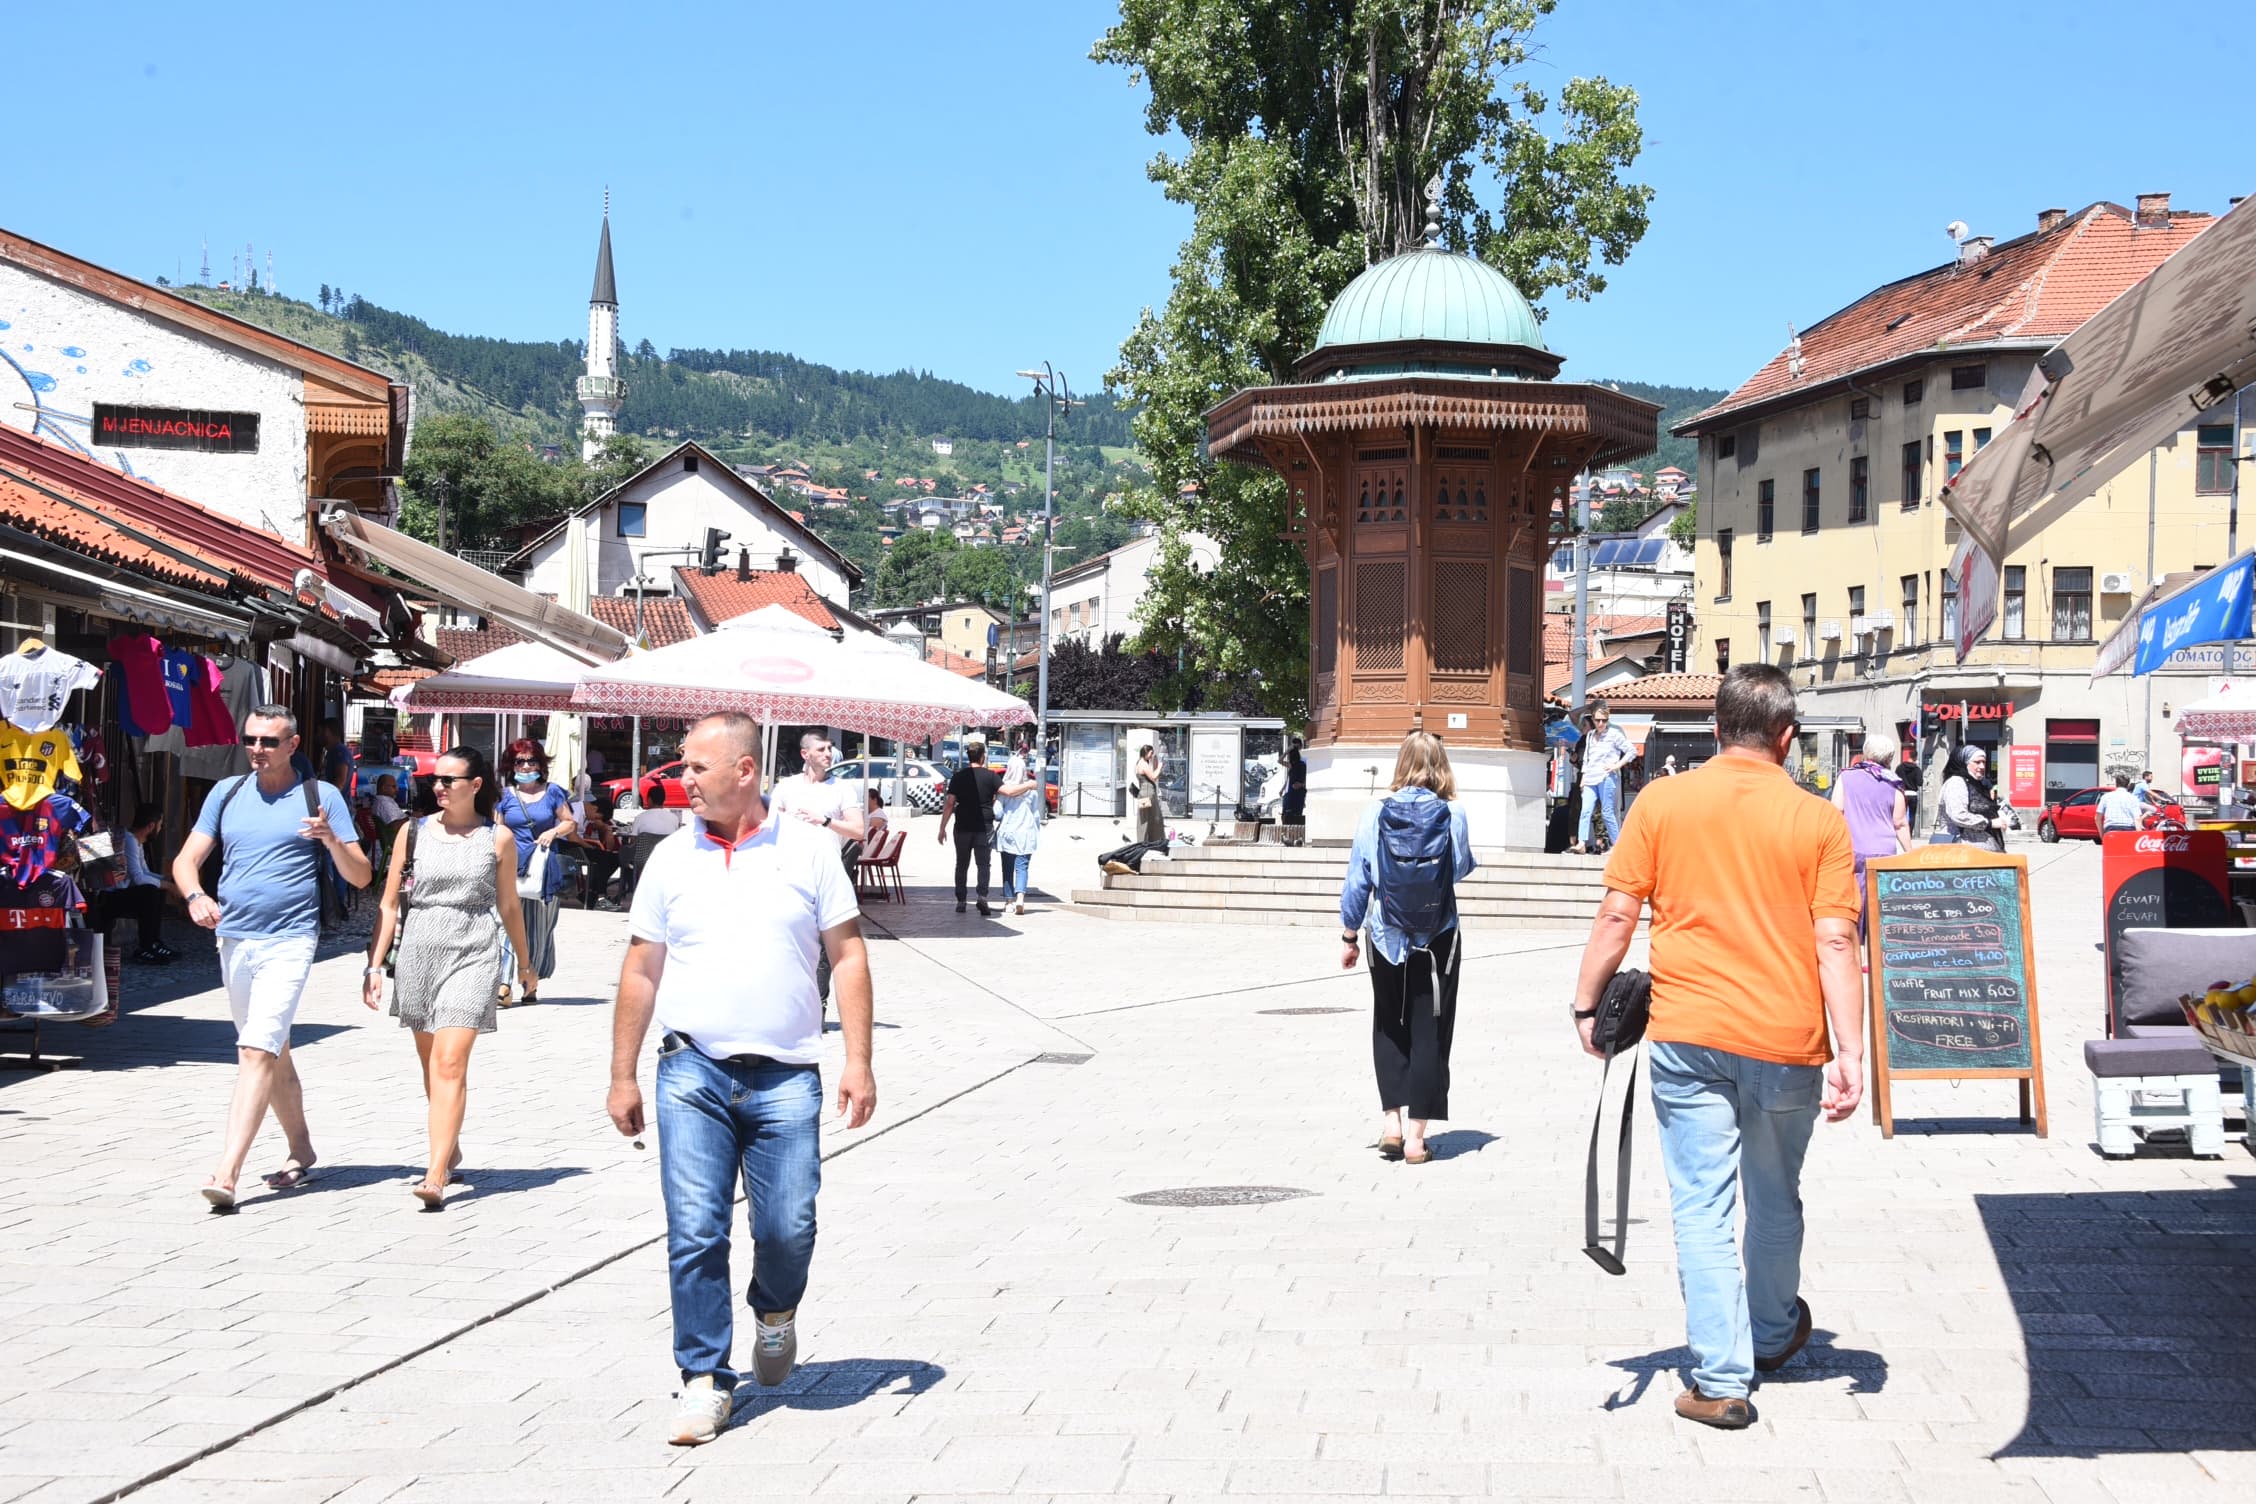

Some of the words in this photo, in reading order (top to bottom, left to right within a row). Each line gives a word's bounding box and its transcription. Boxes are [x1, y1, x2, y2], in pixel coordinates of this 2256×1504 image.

[102, 417, 232, 439] MJENJACNICA
[1670, 613, 1684, 674] HOTEL
[1890, 876, 1945, 892] Combo
[2118, 891, 2161, 905] ĆEVAPI
[1923, 988, 1953, 1000] FRUIT
[1959, 987, 1981, 998] MIX
[1935, 1033, 1977, 1048] FREE
